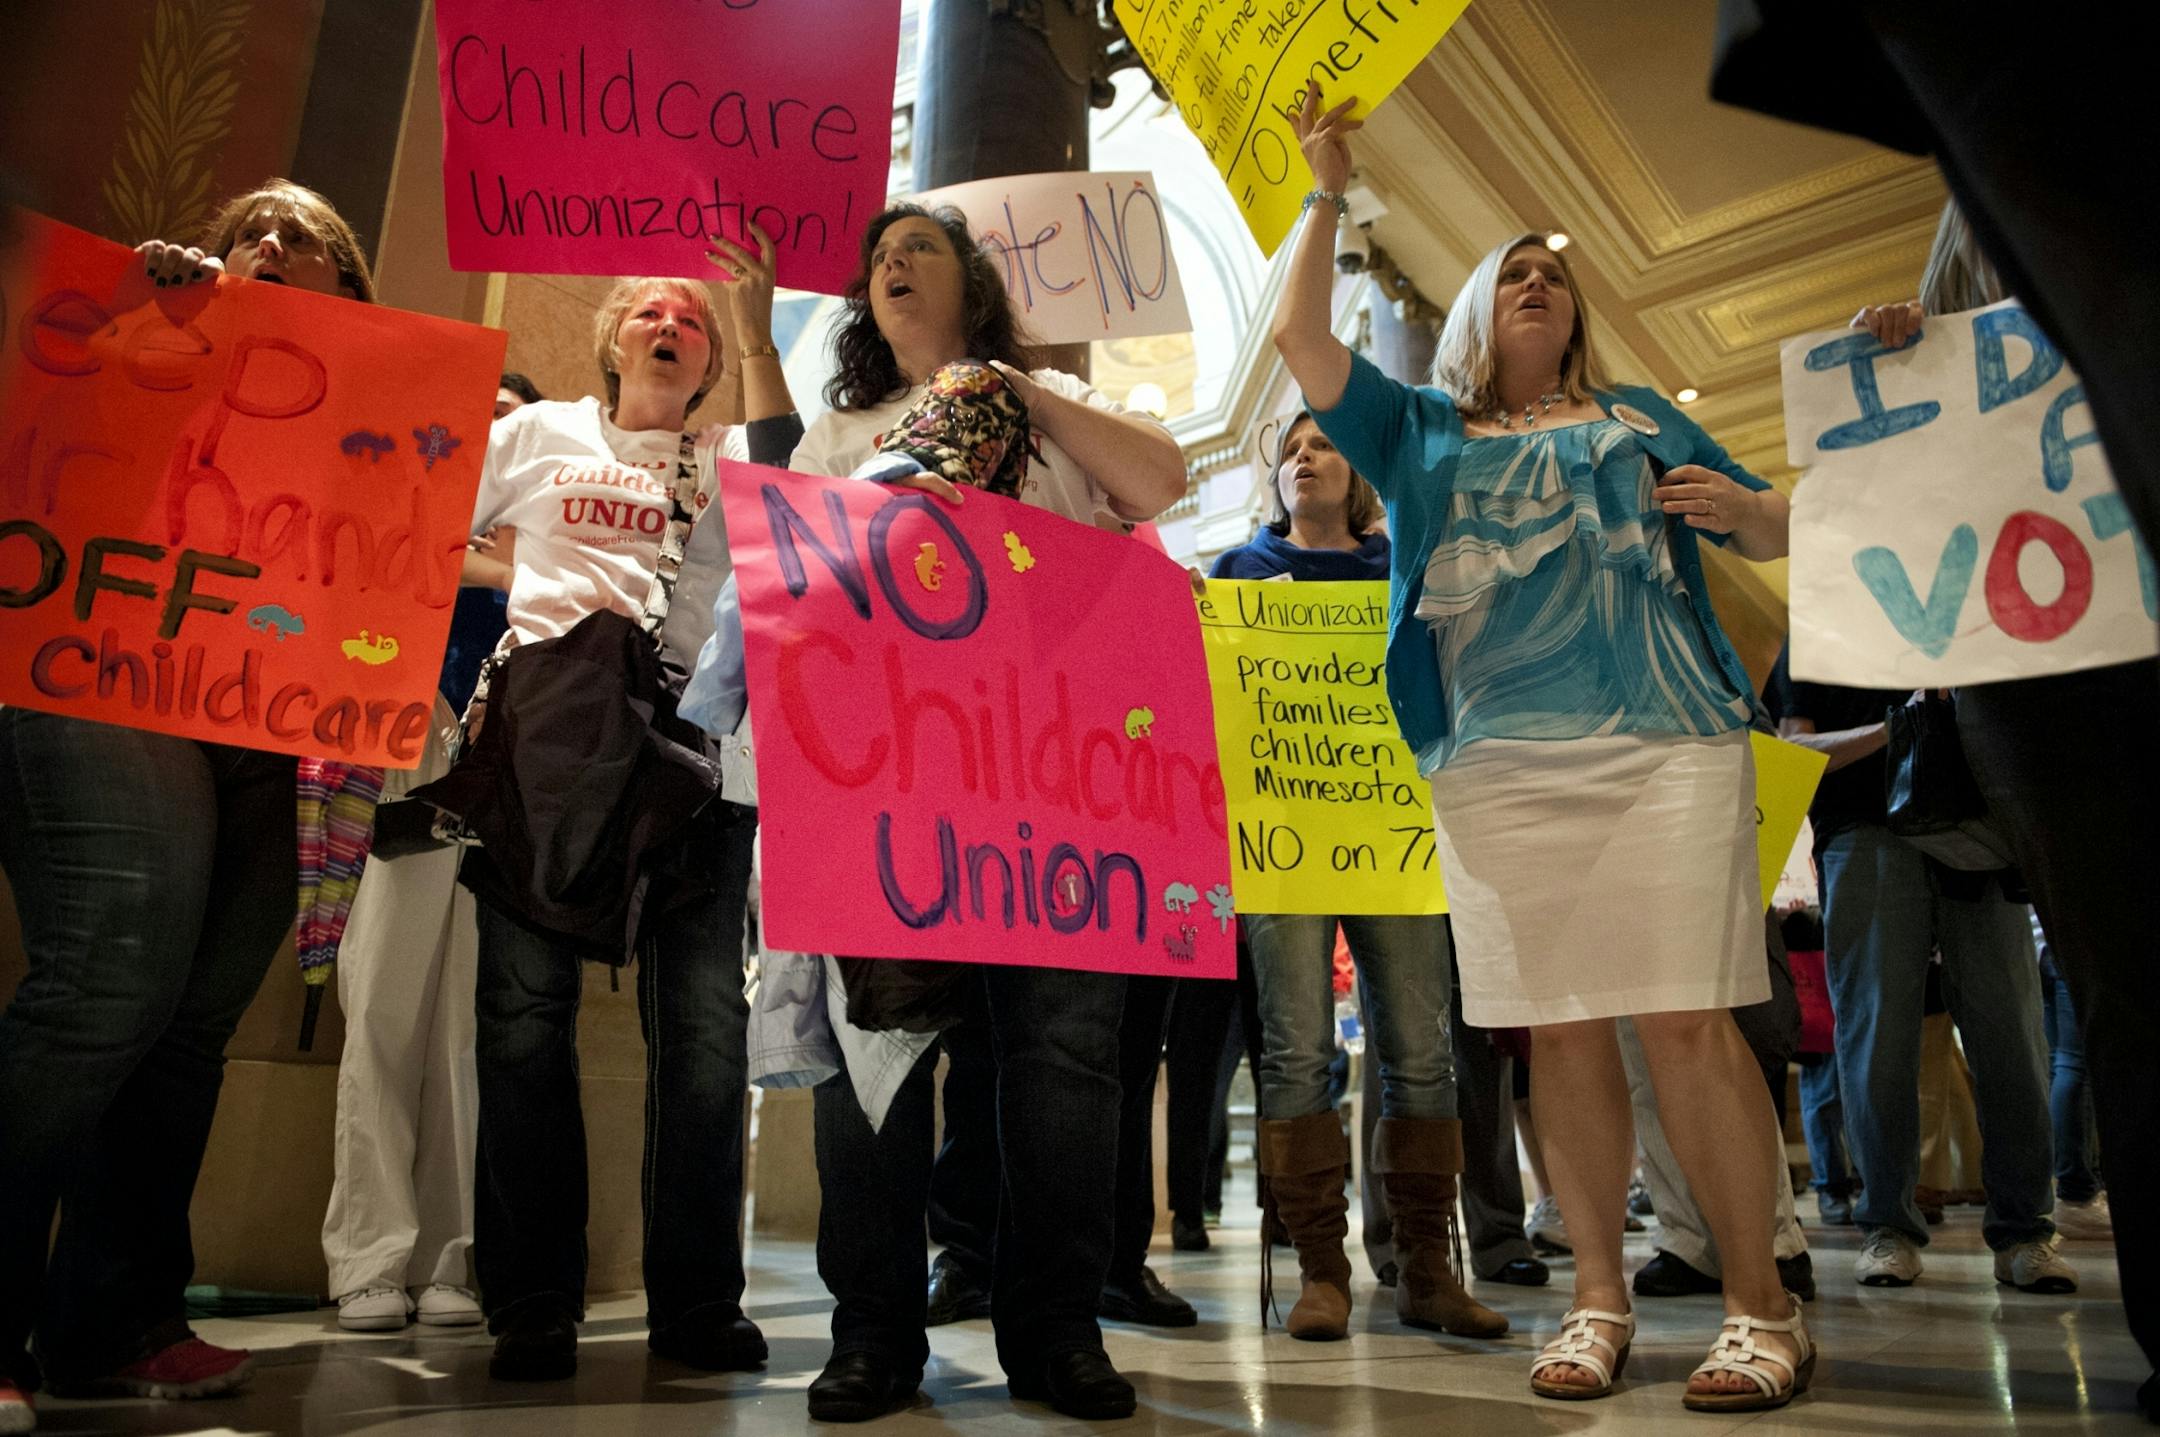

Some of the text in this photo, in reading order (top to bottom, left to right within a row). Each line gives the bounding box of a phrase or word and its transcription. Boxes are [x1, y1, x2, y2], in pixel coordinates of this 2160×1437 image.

[1258, 0, 1307, 49] take
[451, 35, 858, 162] Childcare
[470, 170, 853, 258] Unionization!
[1076, 180, 1168, 330] NO
[18, 288, 328, 466] eep
[1803, 306, 2067, 452] I D
[166, 437, 469, 610] hands
[562, 497, 667, 535] UNIO
[760, 484, 989, 641] NO
[0, 519, 262, 640] OFF
[1236, 585, 1389, 628] Unionizati
[30, 627, 431, 761] childcare
[776, 629, 1227, 842] Childcare
[1250, 728, 1395, 769] children
[1252, 687, 1389, 726] families
[1237, 819, 1304, 873] NO
[1331, 843, 1378, 872] on
[1254, 765, 1424, 810] Minnesota
[873, 811, 1148, 944] Union
